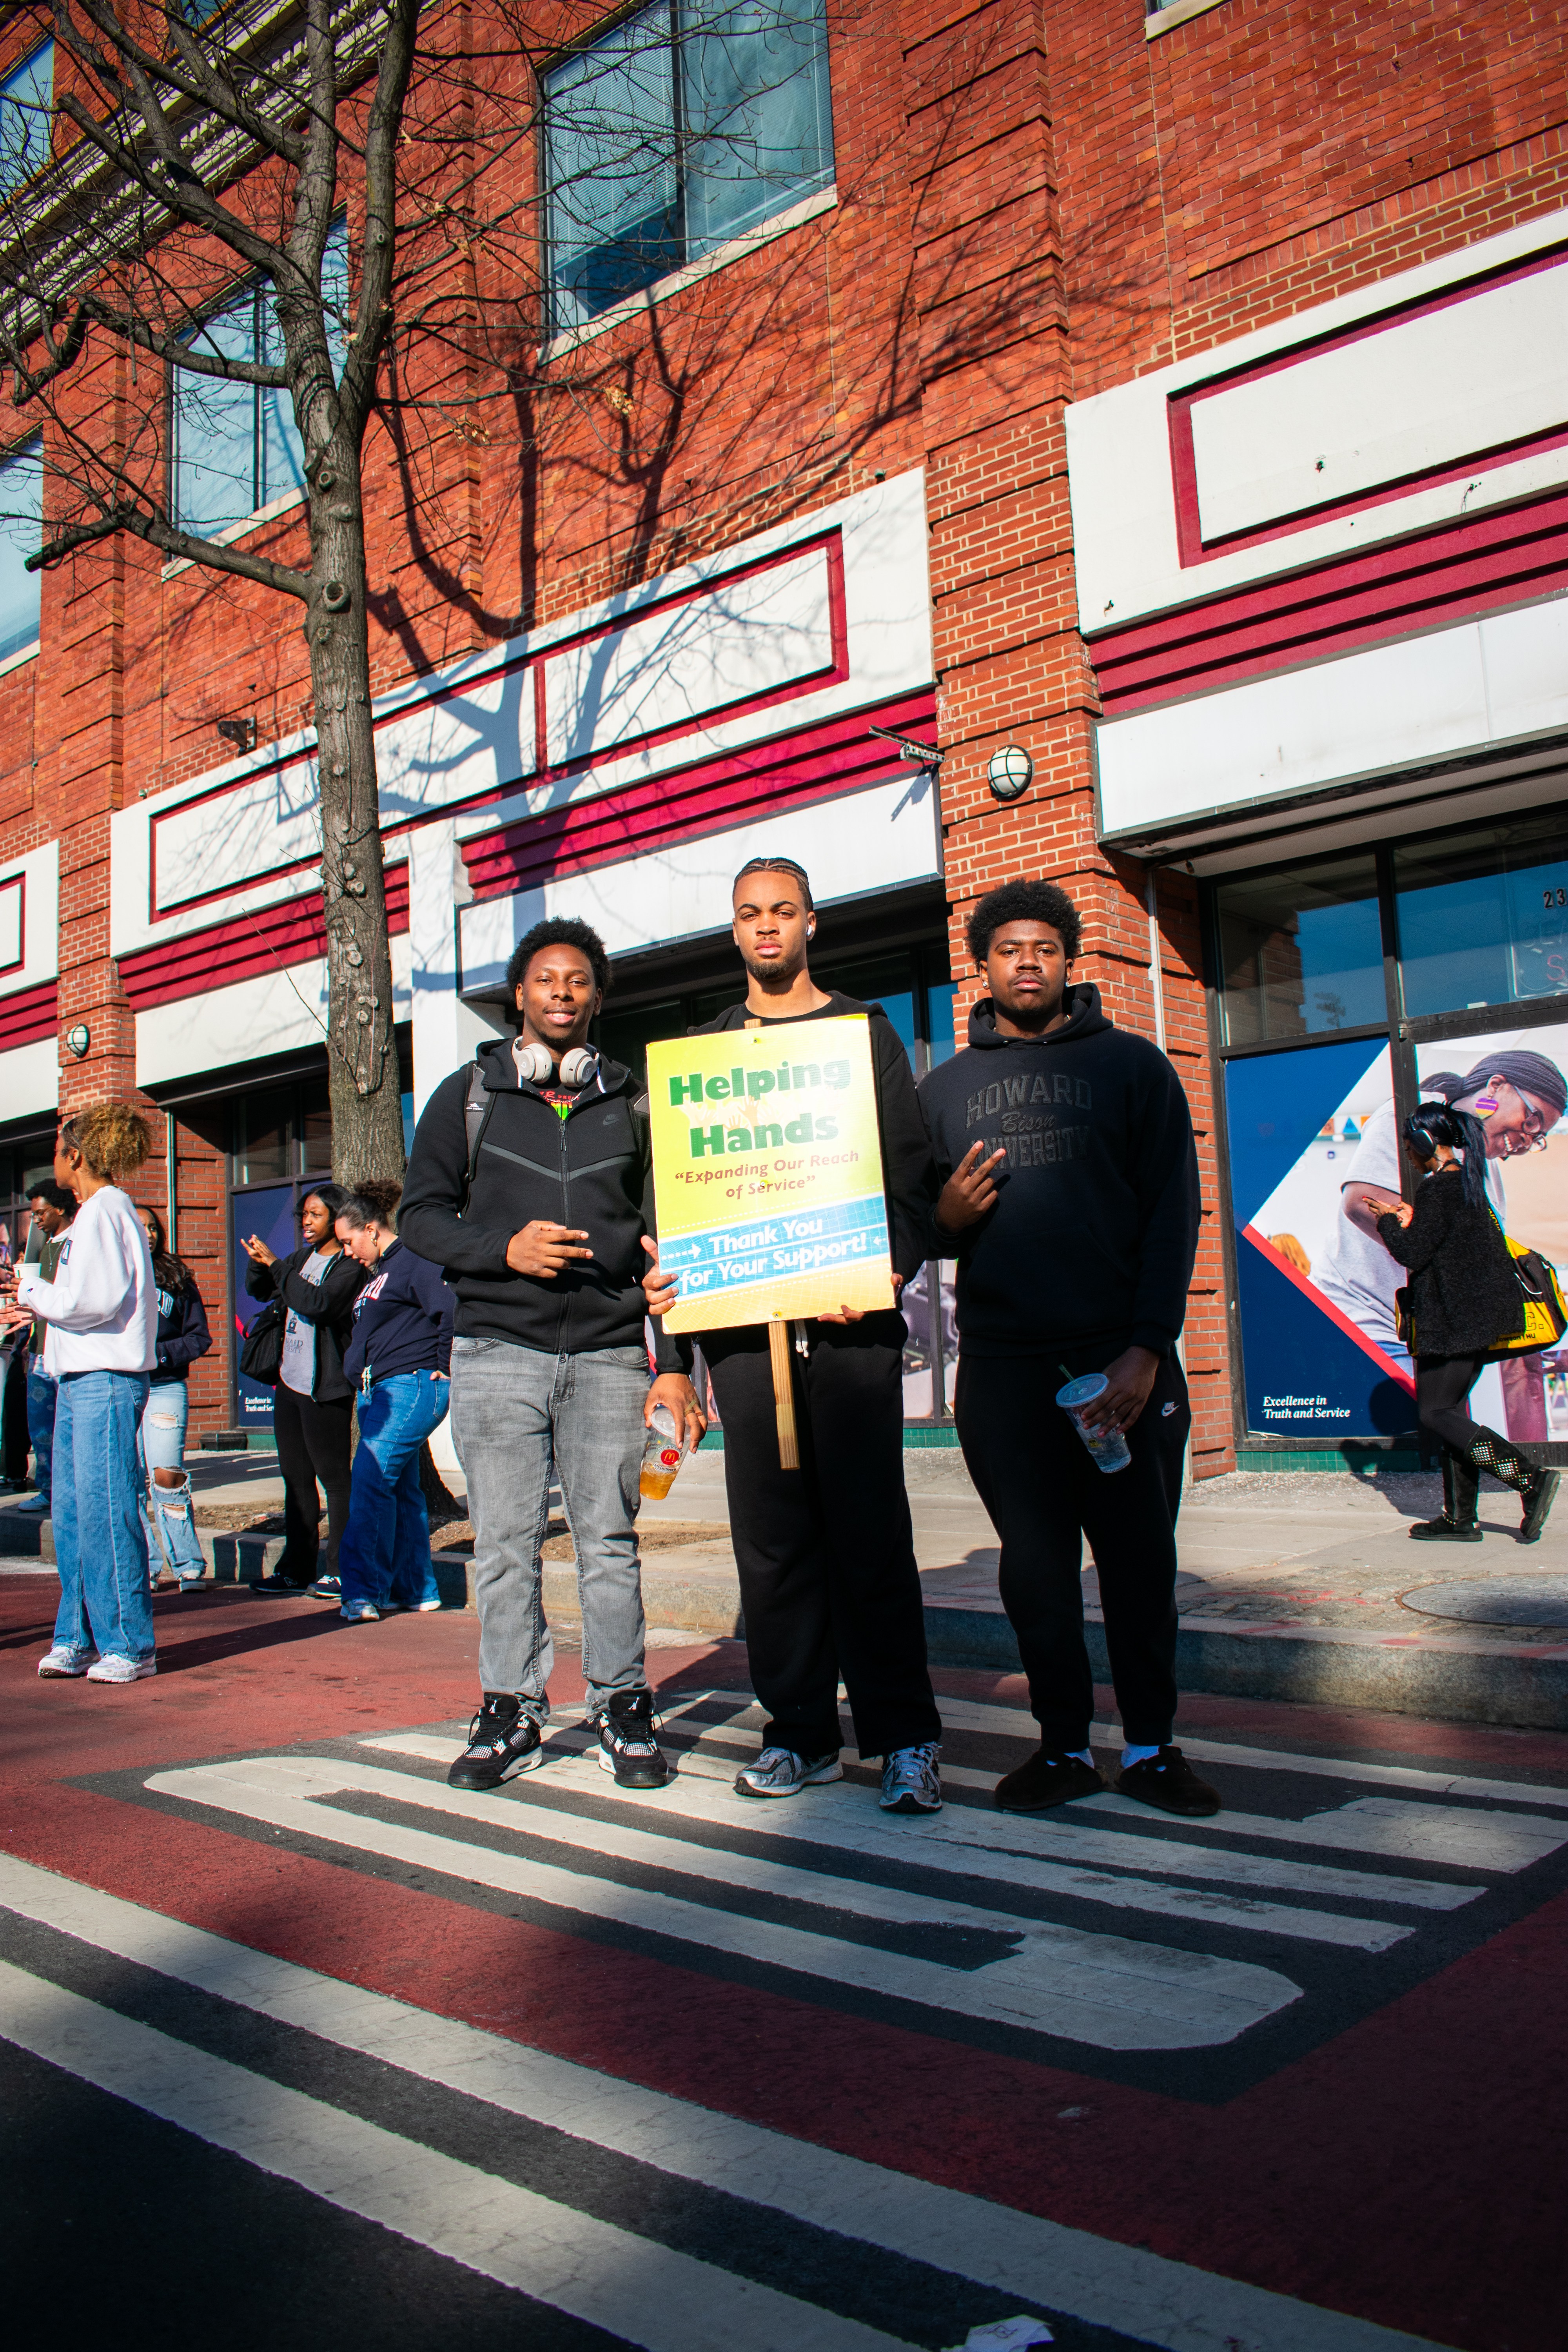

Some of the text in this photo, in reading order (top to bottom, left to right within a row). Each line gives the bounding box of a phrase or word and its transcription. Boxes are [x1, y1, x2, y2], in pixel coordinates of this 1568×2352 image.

[669, 1059, 851, 1107] Helping
[964, 1071, 1093, 1131] HOWARD
[690, 1112, 839, 1158] Hands
[1000, 1111, 1055, 1134] Bison
[773, 1158, 804, 1171] Our
[810, 1150, 859, 1167] Reach
[726, 1184, 744, 1200] of
[708, 1218, 822, 1255] Thank You
[680, 1232, 867, 1294] for Your Support!
[1262, 1395, 1327, 1406] Excellence in
[1264, 1407, 1351, 1419] Truth and Service
